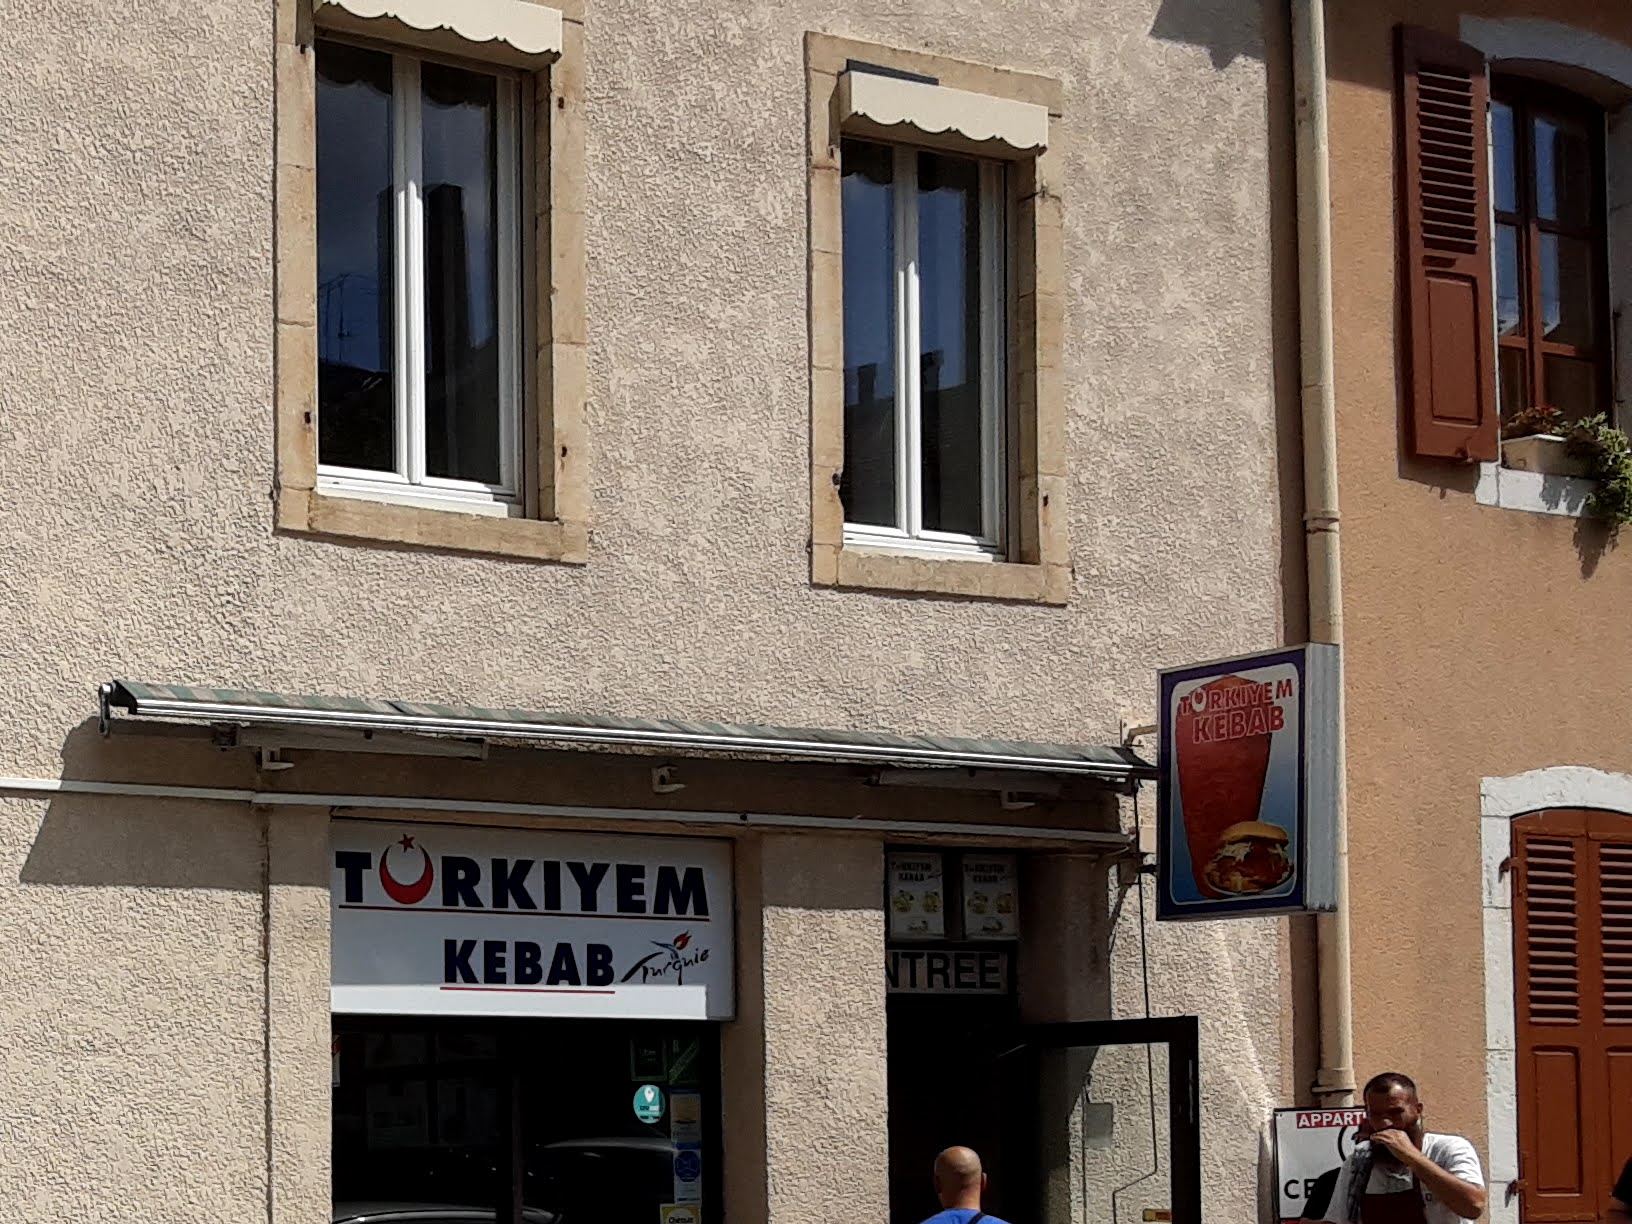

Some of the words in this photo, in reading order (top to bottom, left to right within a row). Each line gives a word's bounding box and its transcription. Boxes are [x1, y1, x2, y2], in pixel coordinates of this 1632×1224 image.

[1192, 705, 1285, 744] KEBAB
[444, 938, 615, 987] KEBAB
[1298, 1111, 1367, 1128] APPART
